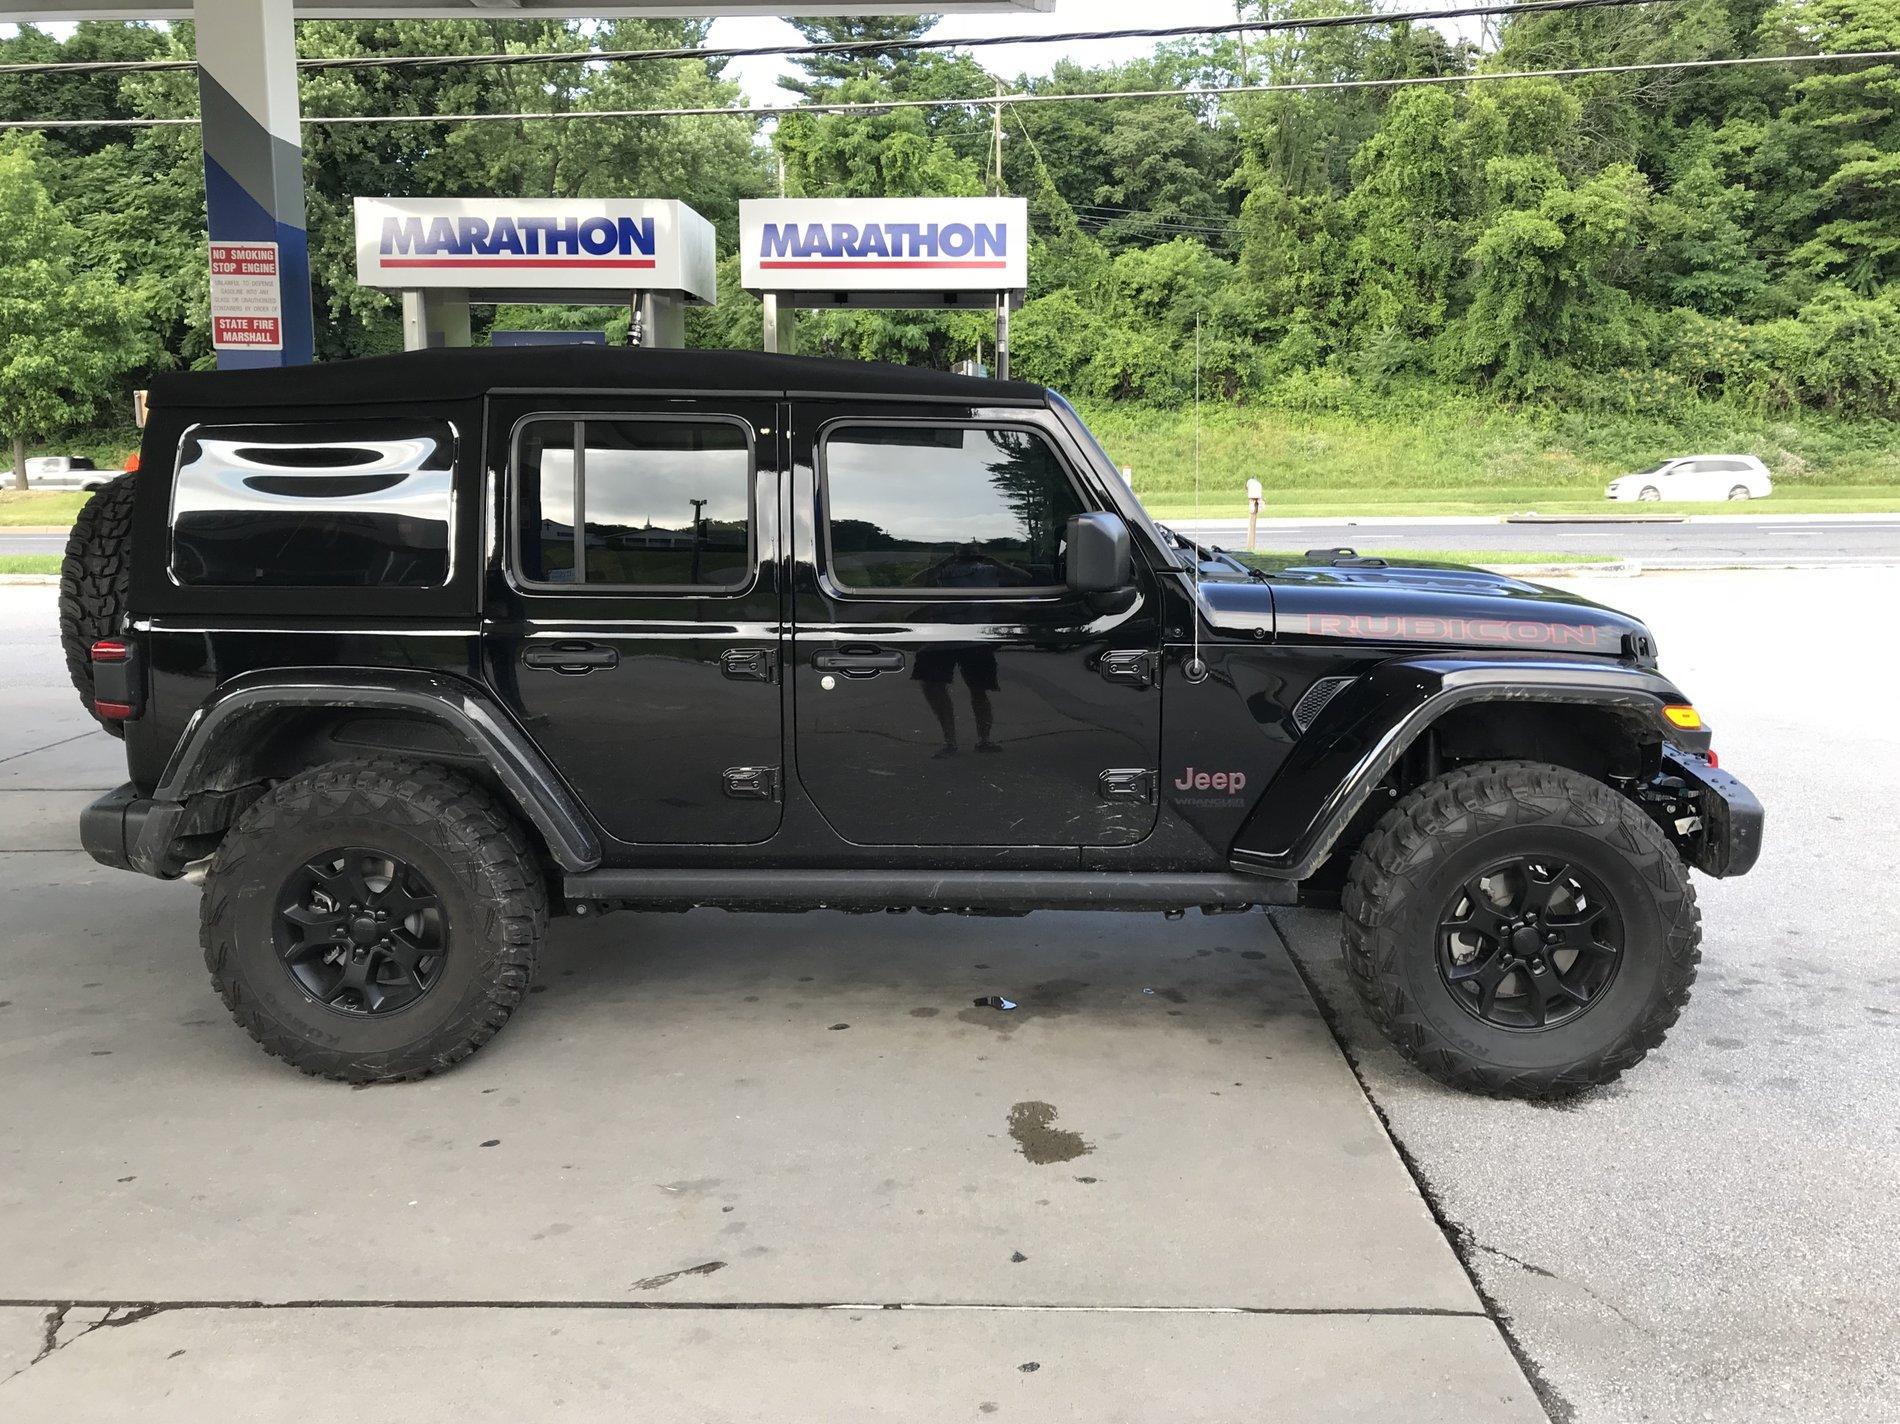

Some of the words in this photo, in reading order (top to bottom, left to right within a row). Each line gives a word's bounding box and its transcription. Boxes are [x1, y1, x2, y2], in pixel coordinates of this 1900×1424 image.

[380, 217, 655, 256] MARATHON
[760, 223, 1007, 257] MARATHON
[212, 249, 226, 259] NO
[231, 249, 274, 260] SMOKING
[212, 262, 237, 273] STOP
[242, 263, 275, 273] ENGINE
[220, 319, 248, 329] STATE
[253, 320, 274, 330] FIRE
[223, 332, 272, 342] MARSHALL
[1307, 614, 1597, 646] RUBICON
[1174, 767, 1246, 794] Jeep
